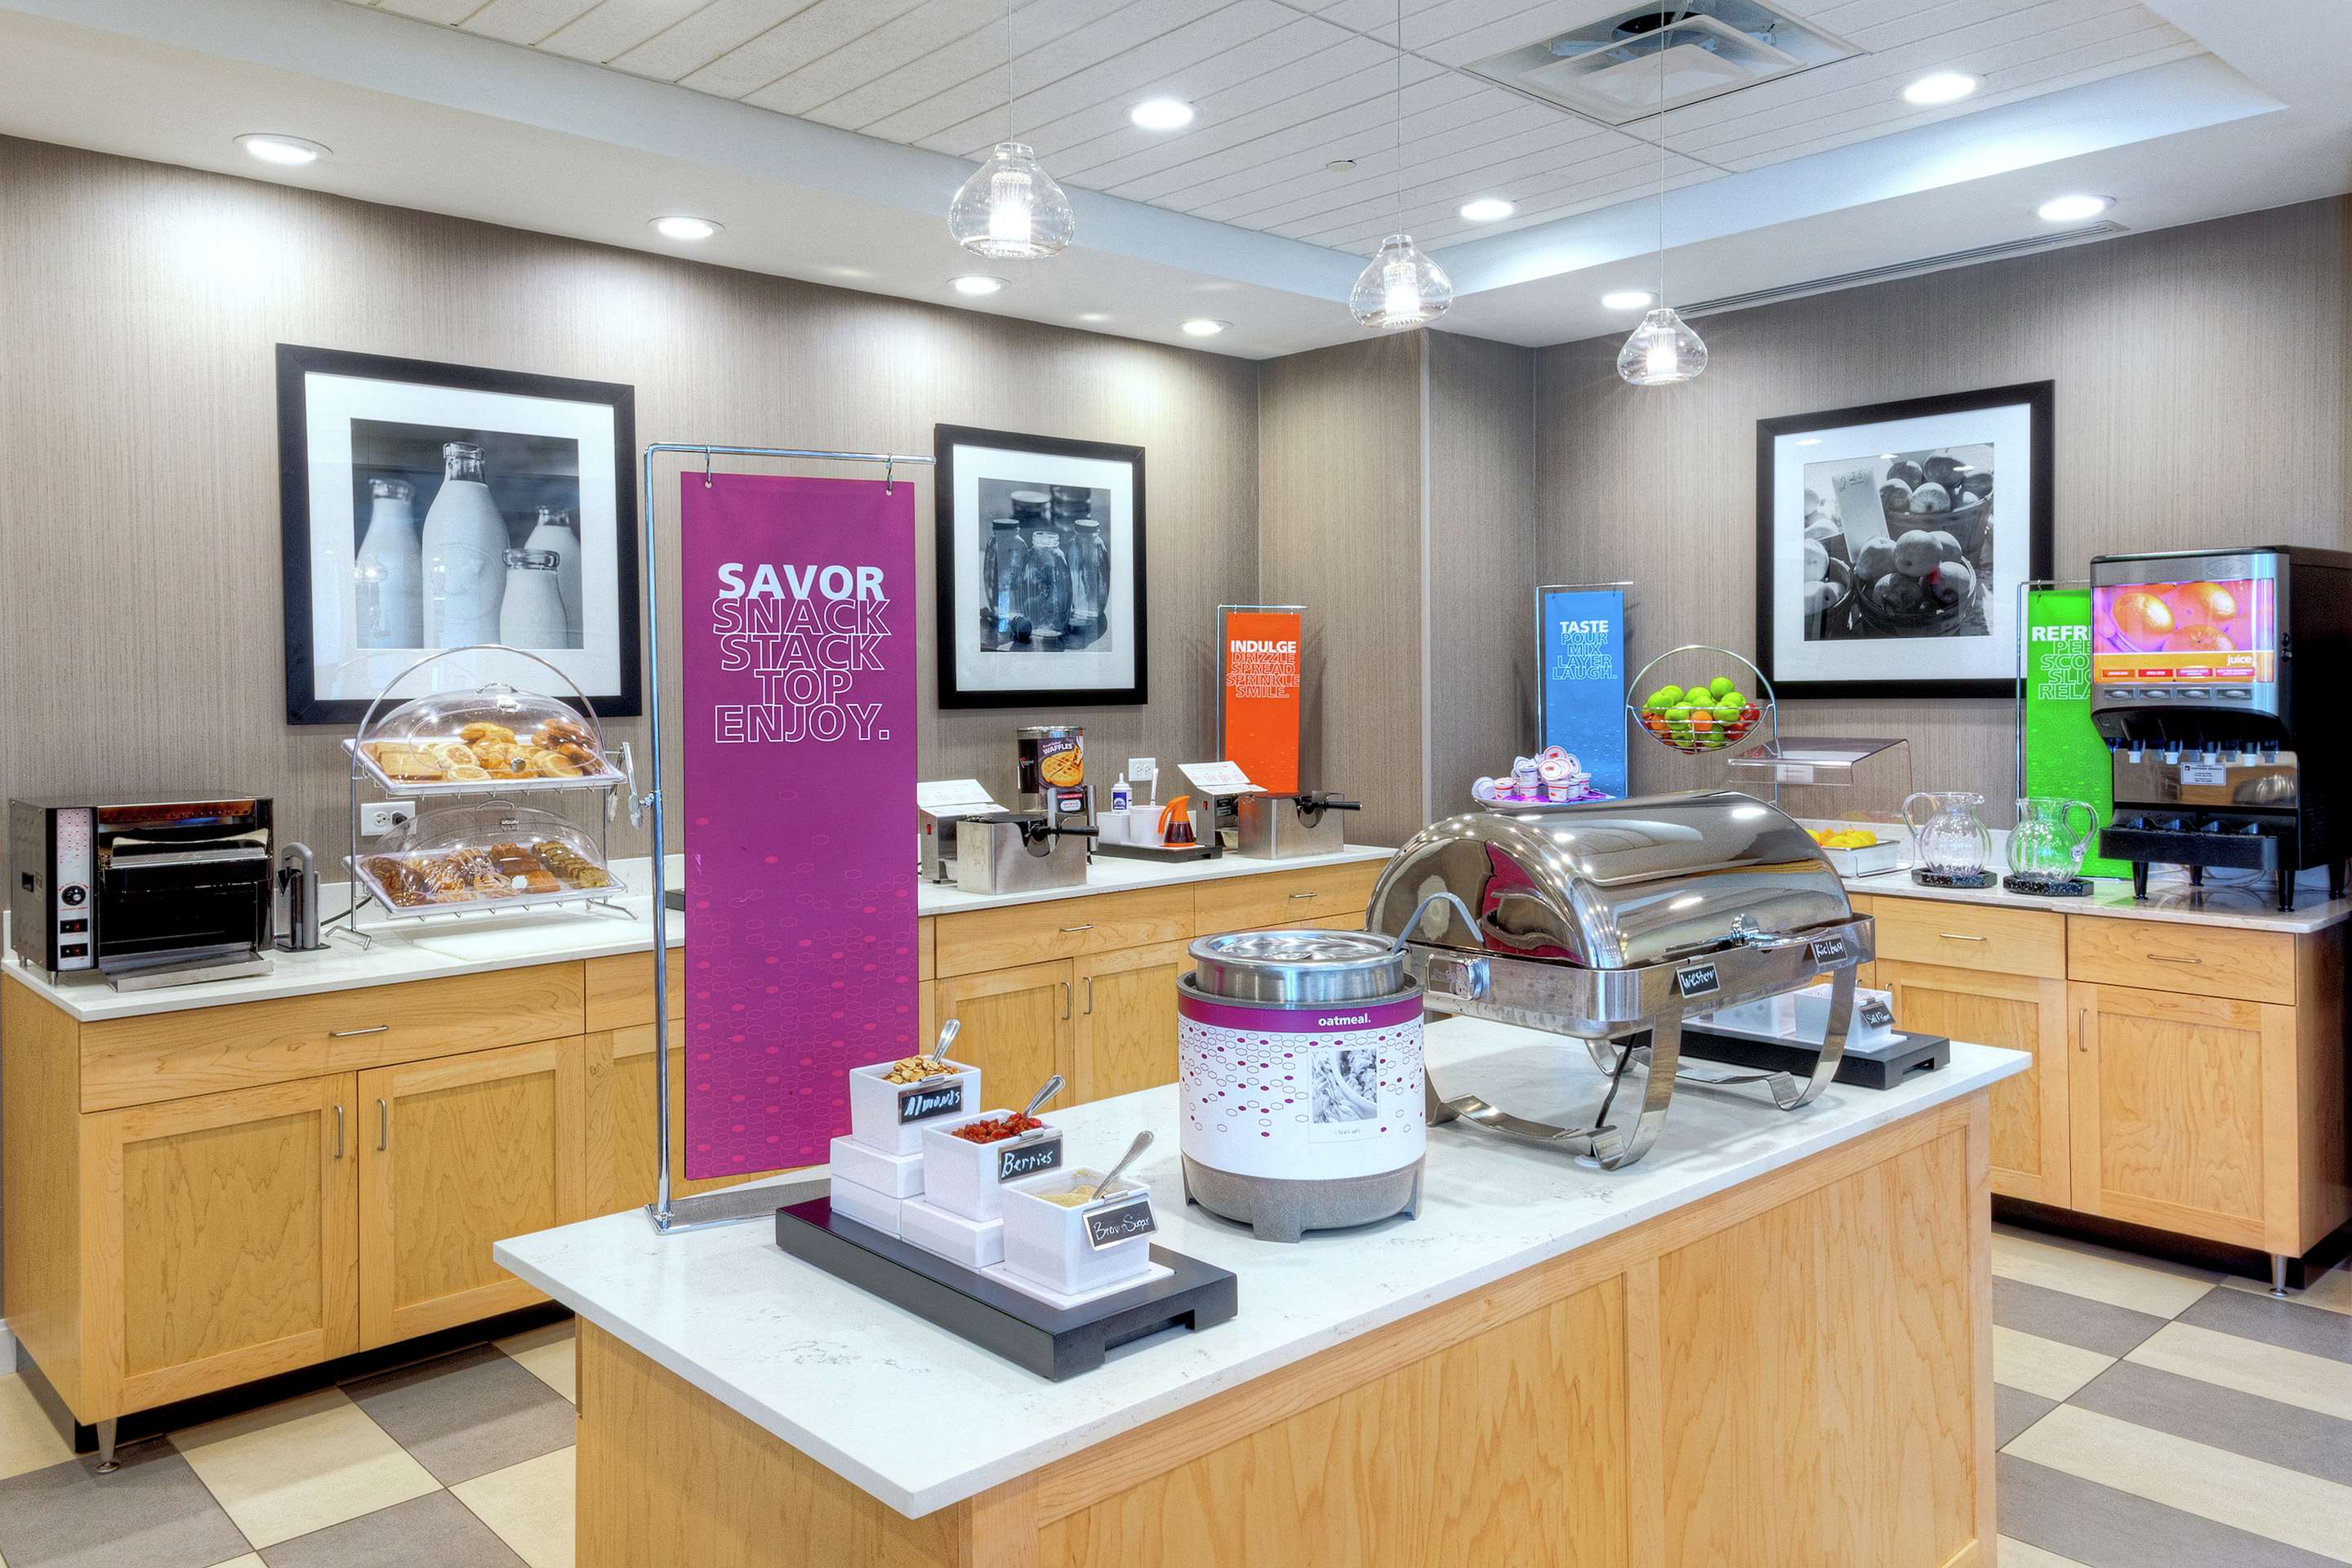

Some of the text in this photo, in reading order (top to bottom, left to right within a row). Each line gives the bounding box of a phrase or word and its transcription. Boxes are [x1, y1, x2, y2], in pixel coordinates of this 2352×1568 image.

[717, 563, 884, 601] SAVOR
[712, 597, 892, 635] SNACK
[1559, 620, 1609, 634] TASTE
[2032, 626, 2091, 642] REFR
[1561, 632, 1609, 645] POUR
[720, 633, 884, 671] STACK
[1230, 639, 1297, 653] INDULGE
[1568, 644, 1601, 656] MIX
[1231, 651, 1295, 664] DRIZZLE
[1557, 654, 1613, 668] LAYER
[1231, 662, 1296, 675] SPREAD
[1552, 666, 1618, 680] LAUGH.
[754, 668, 853, 706] TOP
[1226, 674, 1300, 687] SPRINKLE
[1235, 685, 1290, 698] SMILE.
[715, 703, 890, 743] ENJOY.
[1042, 742, 1073, 755] WAFFLES
[1318, 1013, 1372, 1027] oatmeal.
[903, 1089, 960, 1116] Almonds
[1000, 1150, 1054, 1178] Berries
